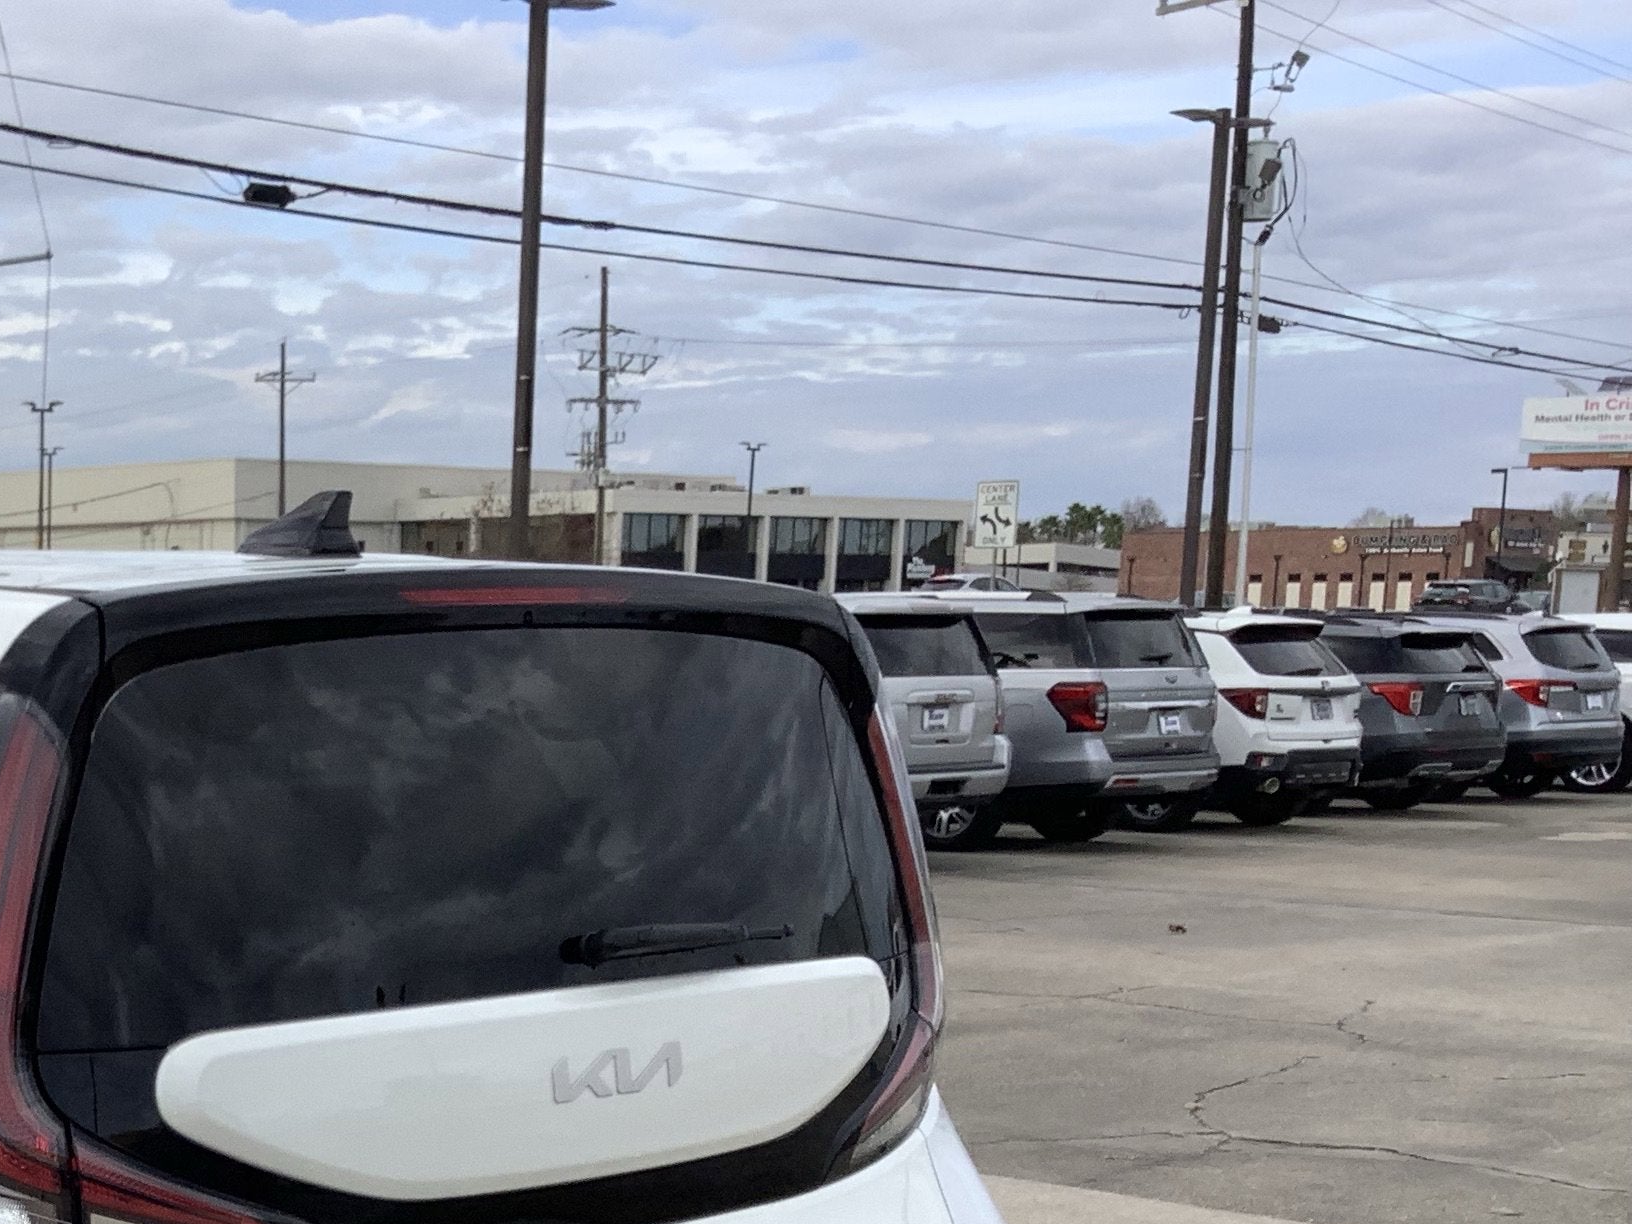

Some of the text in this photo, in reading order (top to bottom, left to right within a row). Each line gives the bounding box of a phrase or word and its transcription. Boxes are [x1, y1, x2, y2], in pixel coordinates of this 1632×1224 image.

[1584, 397, 1632, 411] In Cri
[1534, 414, 1572, 423] Mental
[1574, 412, 1611, 422] Health
[1614, 413, 1626, 422] or
[980, 484, 1017, 494] CENTER
[982, 536, 1008, 545] ONLY
[552, 1041, 683, 1104] KIA
